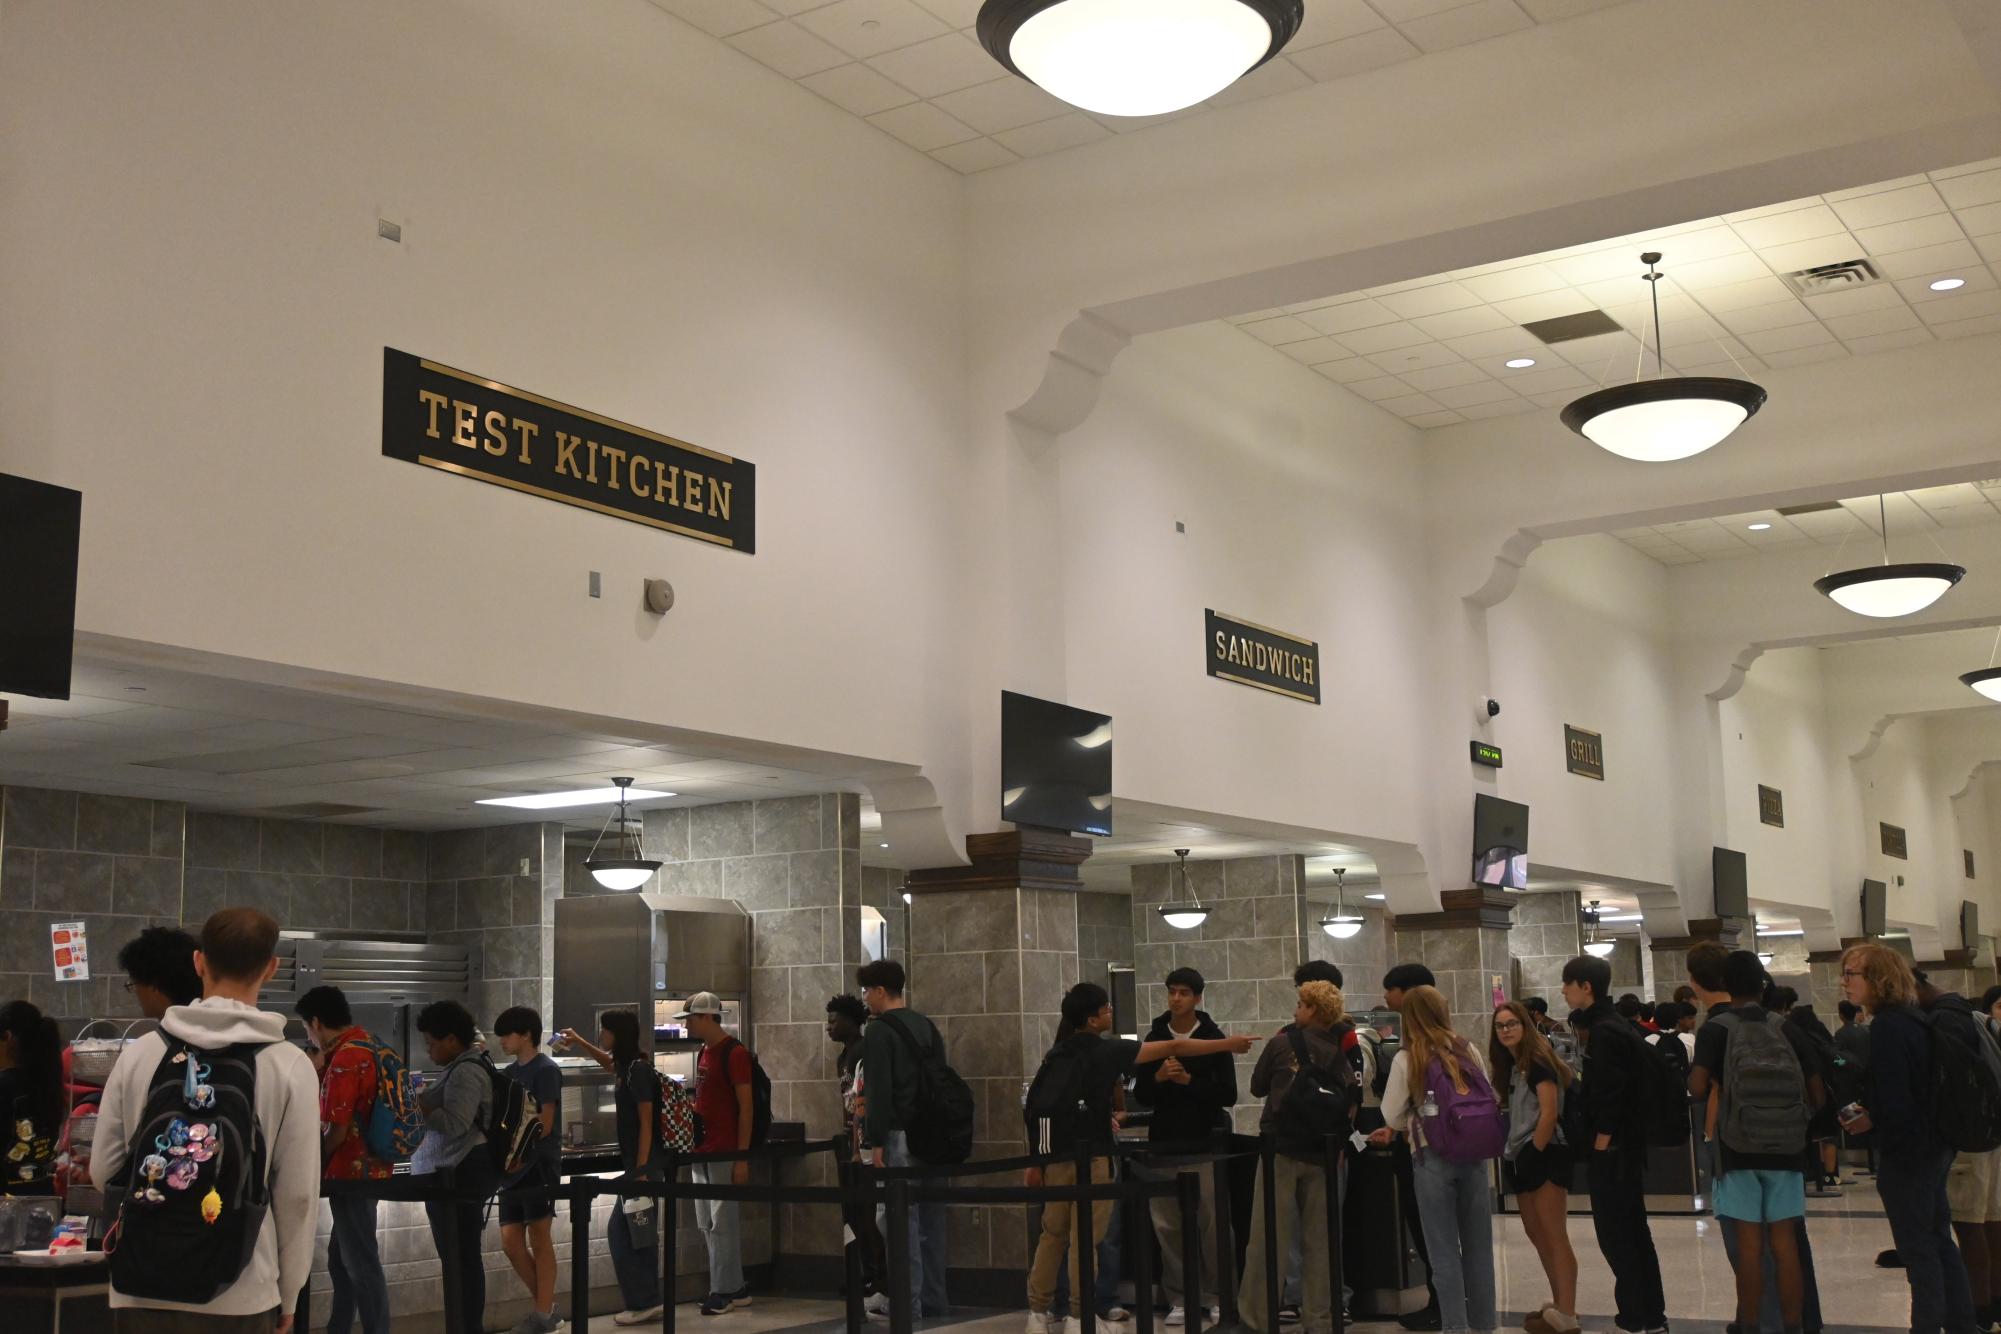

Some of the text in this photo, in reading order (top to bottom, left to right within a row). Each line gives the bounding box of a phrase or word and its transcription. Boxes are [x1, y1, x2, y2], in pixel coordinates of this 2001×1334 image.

[419, 388, 732, 521] TEST KITCHEN
[1215, 630, 1314, 686] SANDWICH
[1570, 739, 1601, 766] GRILL
